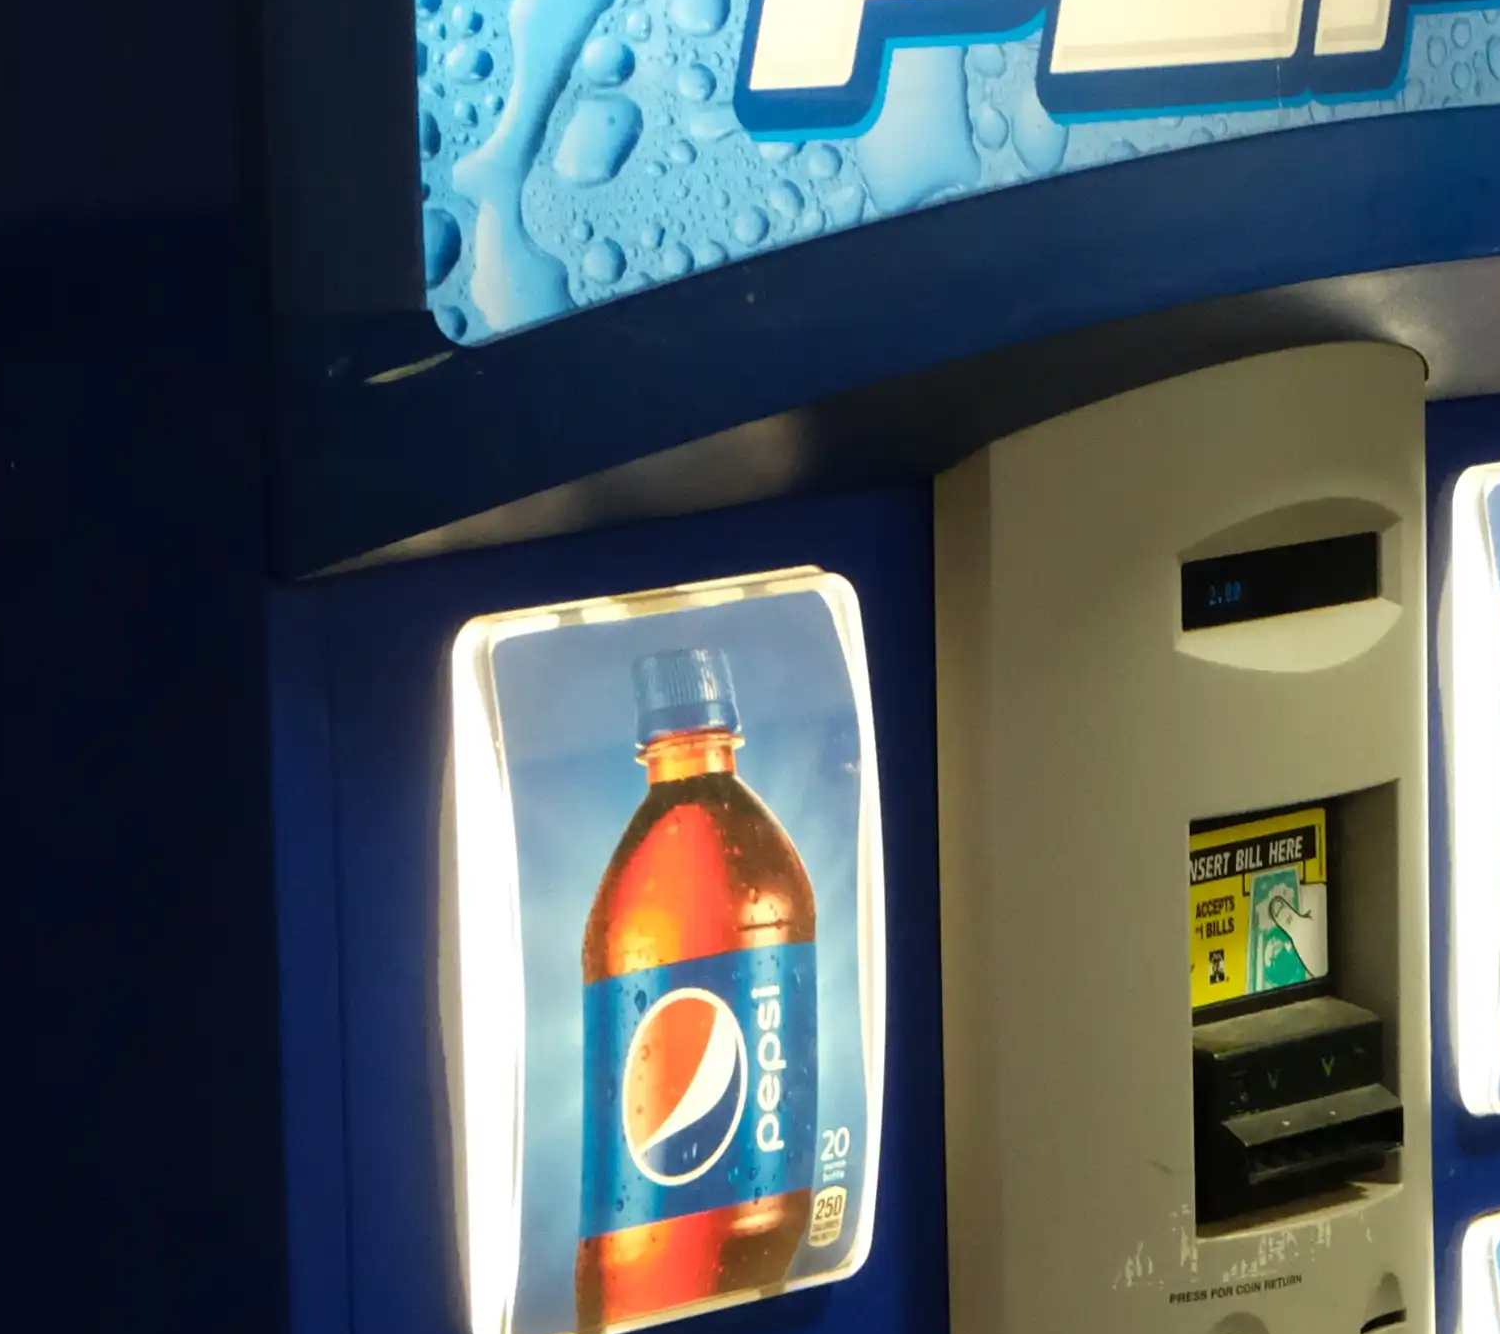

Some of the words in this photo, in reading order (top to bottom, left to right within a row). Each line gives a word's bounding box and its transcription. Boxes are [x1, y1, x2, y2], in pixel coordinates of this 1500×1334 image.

[1189, 852, 1231, 881] NSERT
[1235, 844, 1263, 872] BILL
[1269, 836, 1304, 865] HERE
[1195, 895, 1235, 918] ACCEPTS
[1206, 917, 1235, 938] BILLS
[751, 985, 787, 1152] pepsi
[820, 1126, 850, 1161] 20
[814, 1194, 843, 1220] 250
[1169, 1287, 1208, 1304] PRESS
[1210, 1285, 1234, 1300] FOR
[1235, 1281, 1262, 1296] COIN
[1264, 1274, 1302, 1291] RETURN
